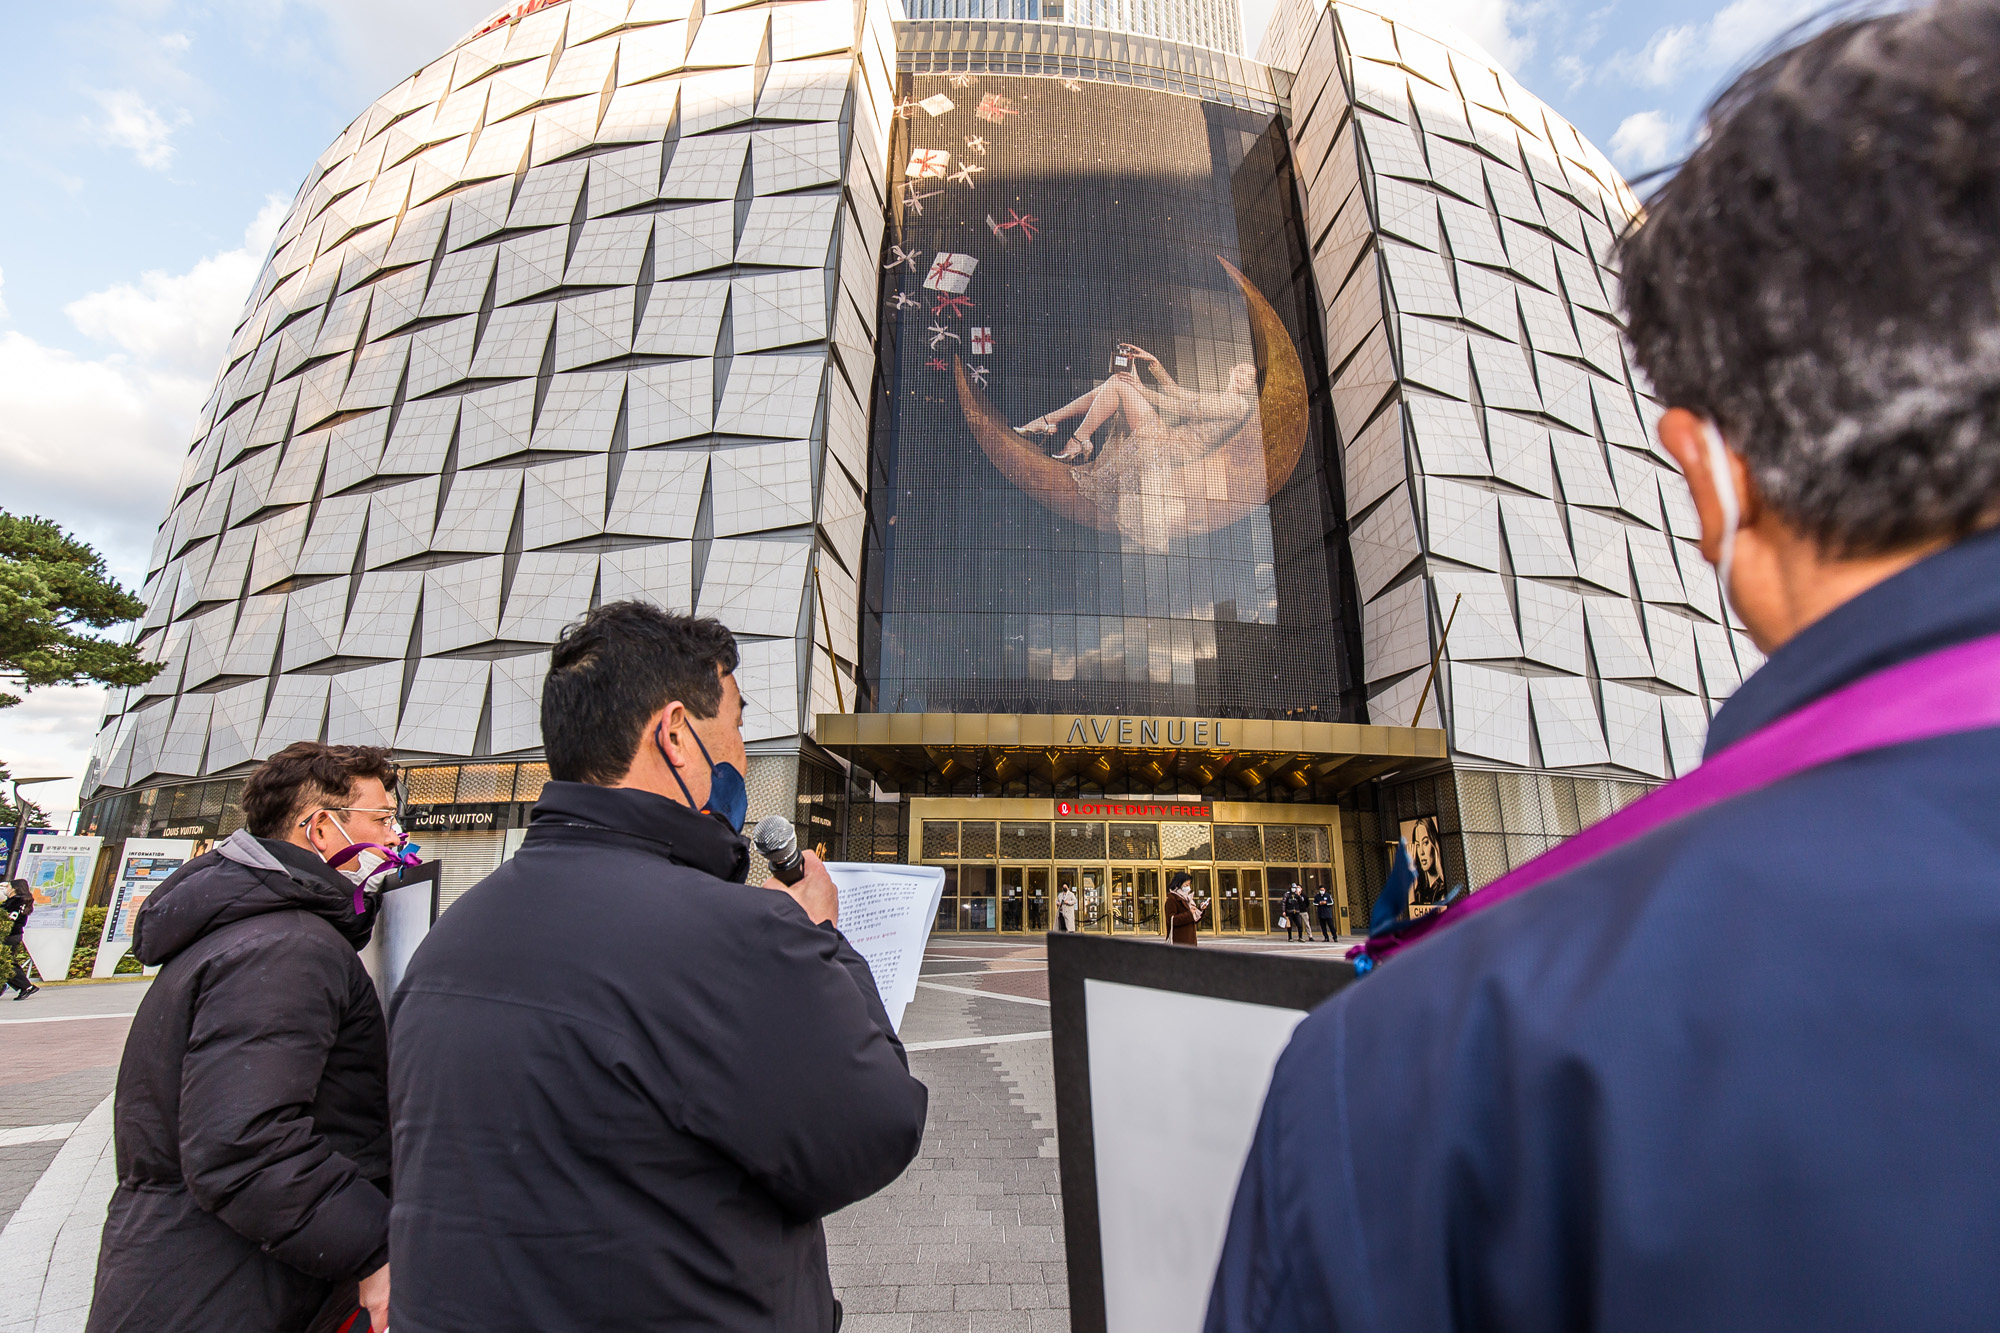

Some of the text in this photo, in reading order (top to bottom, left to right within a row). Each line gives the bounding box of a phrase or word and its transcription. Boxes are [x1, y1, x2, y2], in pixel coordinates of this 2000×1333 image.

[1067, 718, 1230, 746] AVENUEL
[1074, 804, 1210, 817] LOTTE DUTY FREE
[415, 813, 493, 825] LOUIS VUITTON
[163, 825, 204, 837] LOUIS VUITTON
